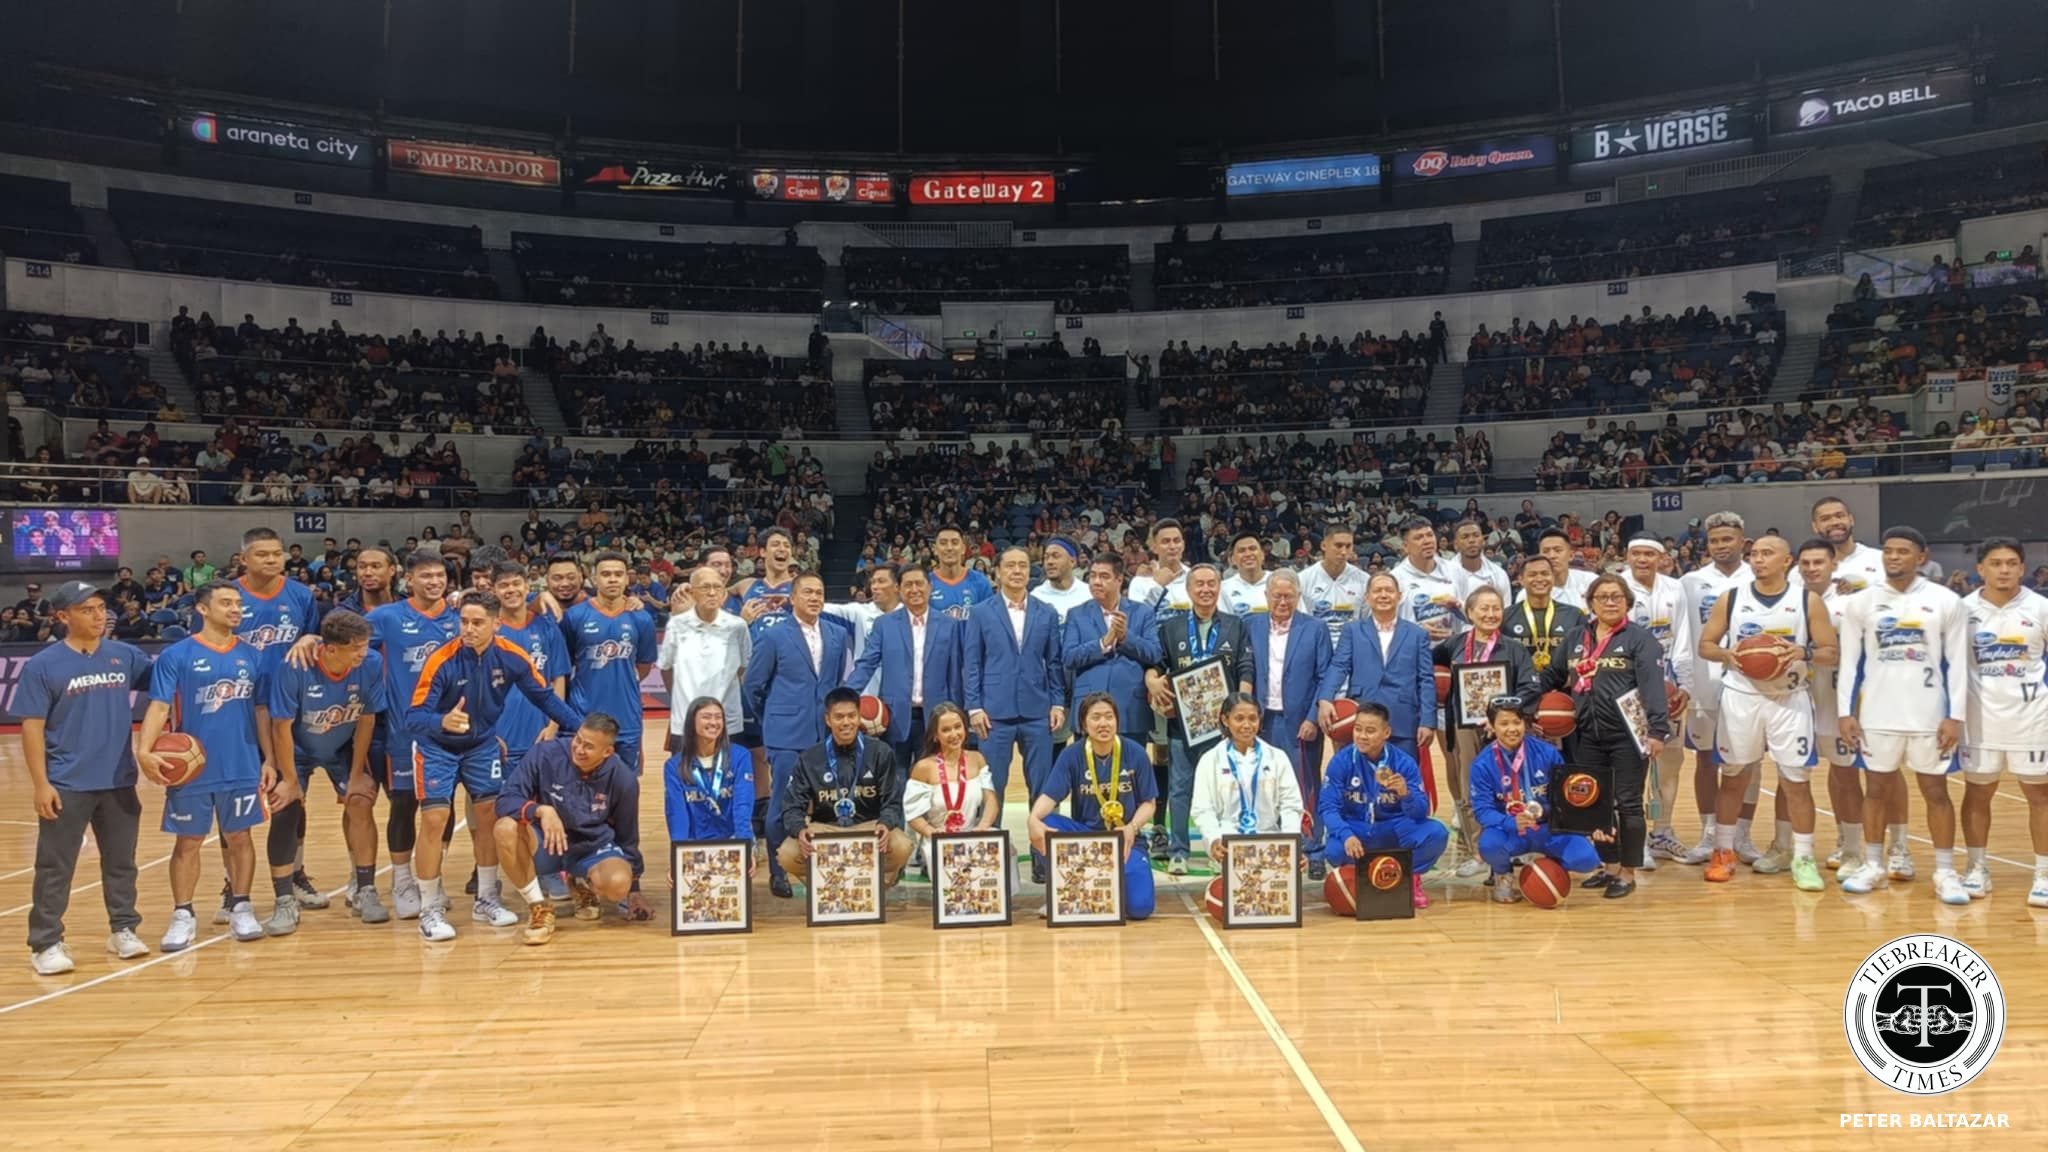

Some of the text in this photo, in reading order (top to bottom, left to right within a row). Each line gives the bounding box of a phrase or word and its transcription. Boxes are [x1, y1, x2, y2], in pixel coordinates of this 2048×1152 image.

[1832, 85, 1938, 116] TACO BELL
[1644, 112, 1728, 151] VERSE
[226, 126, 359, 160] araneta city
[406, 149, 545, 178] EMPERADOR
[1419, 158, 1443, 170] DQ
[630, 166, 684, 186] Pizza
[1227, 164, 1380, 186] GATEWAY CINEPLEX 18
[787, 185, 818, 198] Cignal
[858, 187, 888, 200] Cignal
[1031, 180, 1044, 198] 2
[1992, 383, 2010, 396] 33
[1654, 495, 1680, 508] 116
[296, 515, 325, 529] 112
[67, 672, 126, 691] MERALCO
[1786, 671, 1799, 690] 3
[1923, 667, 1934, 688] 2
[2020, 682, 2038, 703] 17
[1796, 737, 1809, 757] 3
[489, 759, 501, 779] 6
[233, 793, 257, 817] 17
